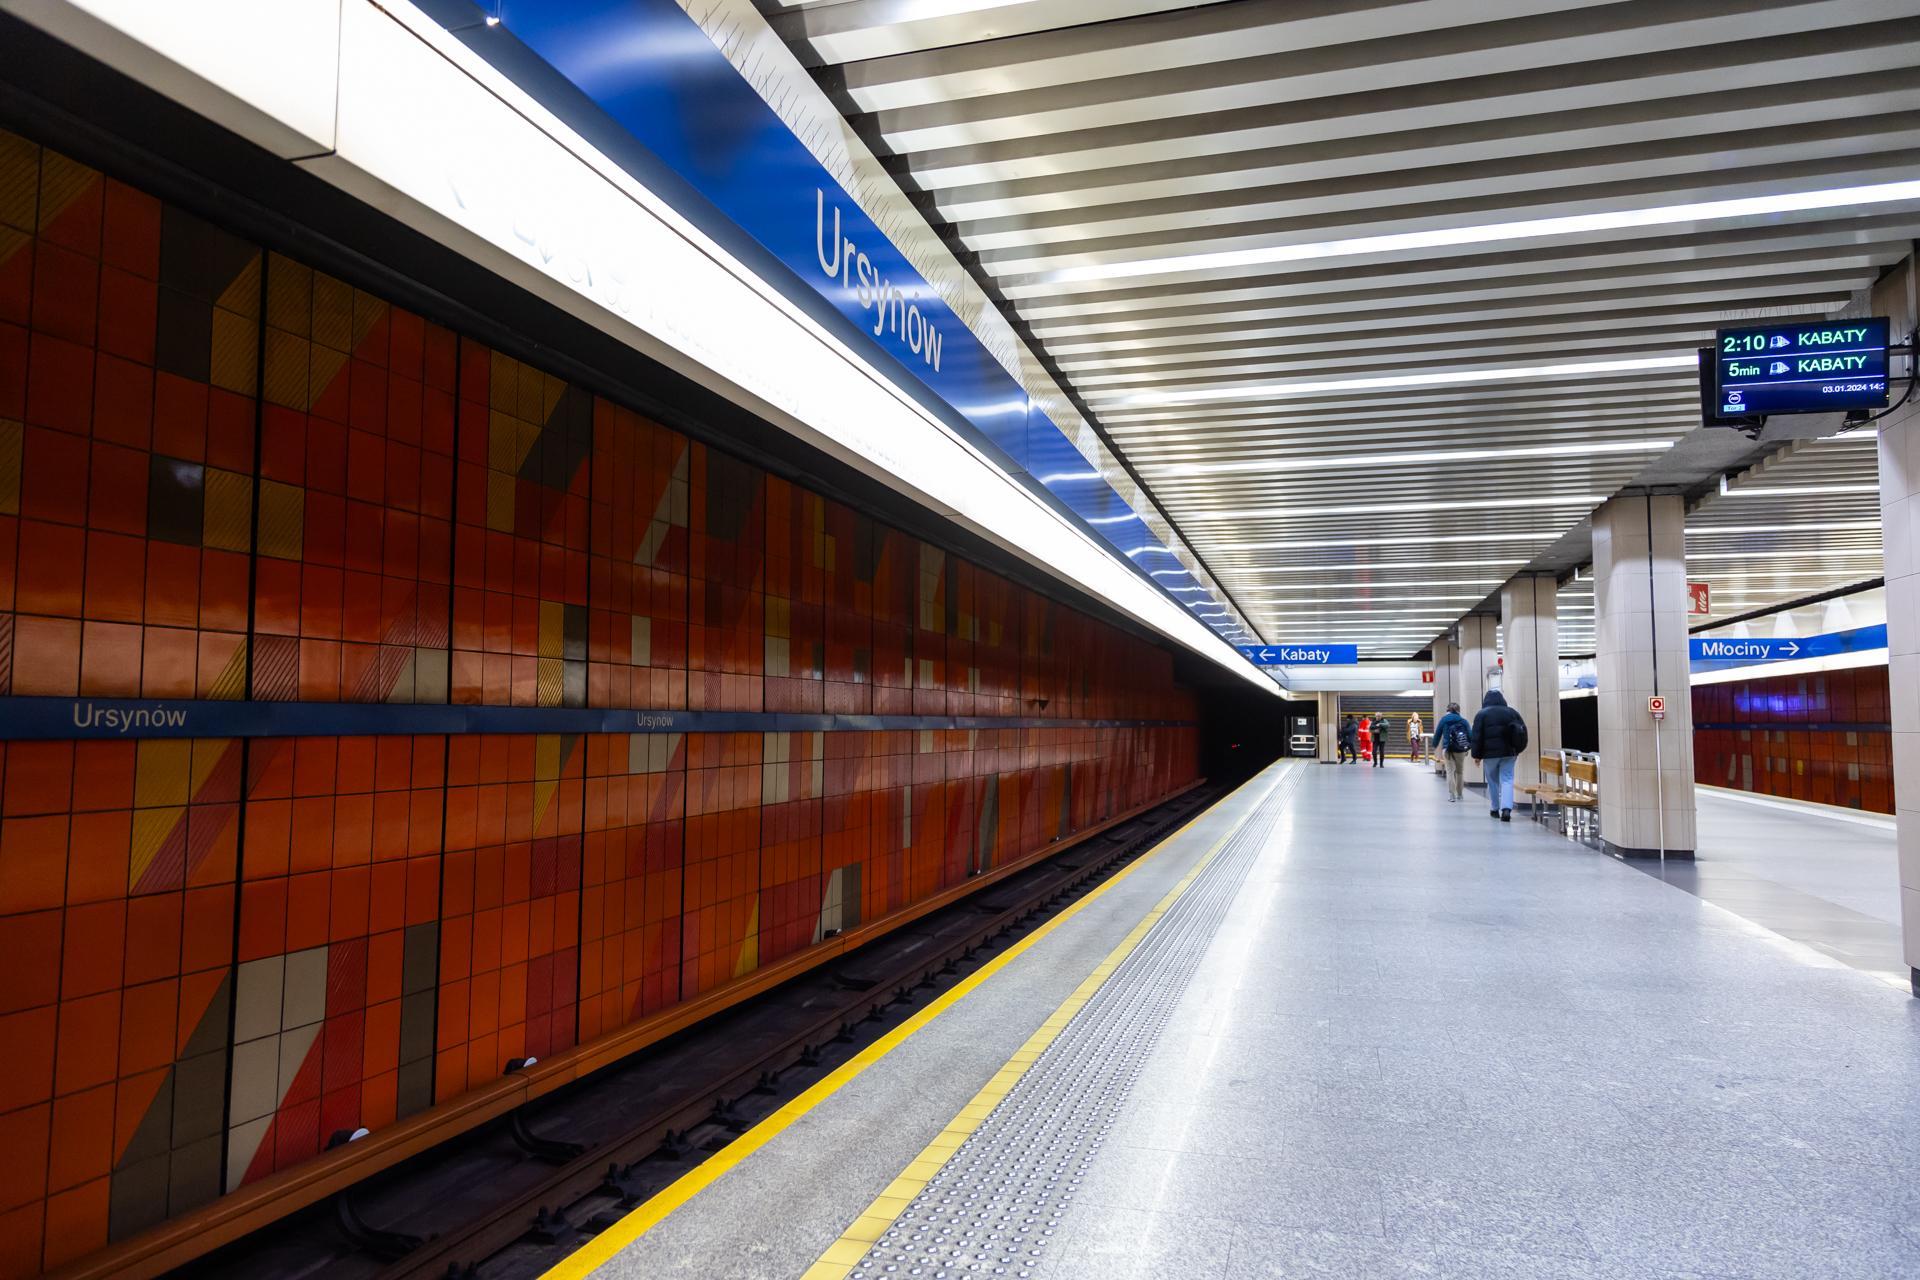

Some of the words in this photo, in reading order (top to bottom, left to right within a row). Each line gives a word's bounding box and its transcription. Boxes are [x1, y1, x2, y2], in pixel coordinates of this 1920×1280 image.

[817, 187, 943, 373] Ursynów
[1723, 335, 1765, 352] 2:10
[1798, 329, 1867, 346] KABATY
[1729, 363, 1760, 377] 5min
[1798, 356, 1867, 373] KABATY
[1822, 384, 1867, 393] 03.01.2024
[1281, 648, 1330, 664] Kabaty
[1702, 641, 1771, 659] Młociny
[74, 702, 187, 733] Ursynów
[637, 712, 674, 729] Ursynów
